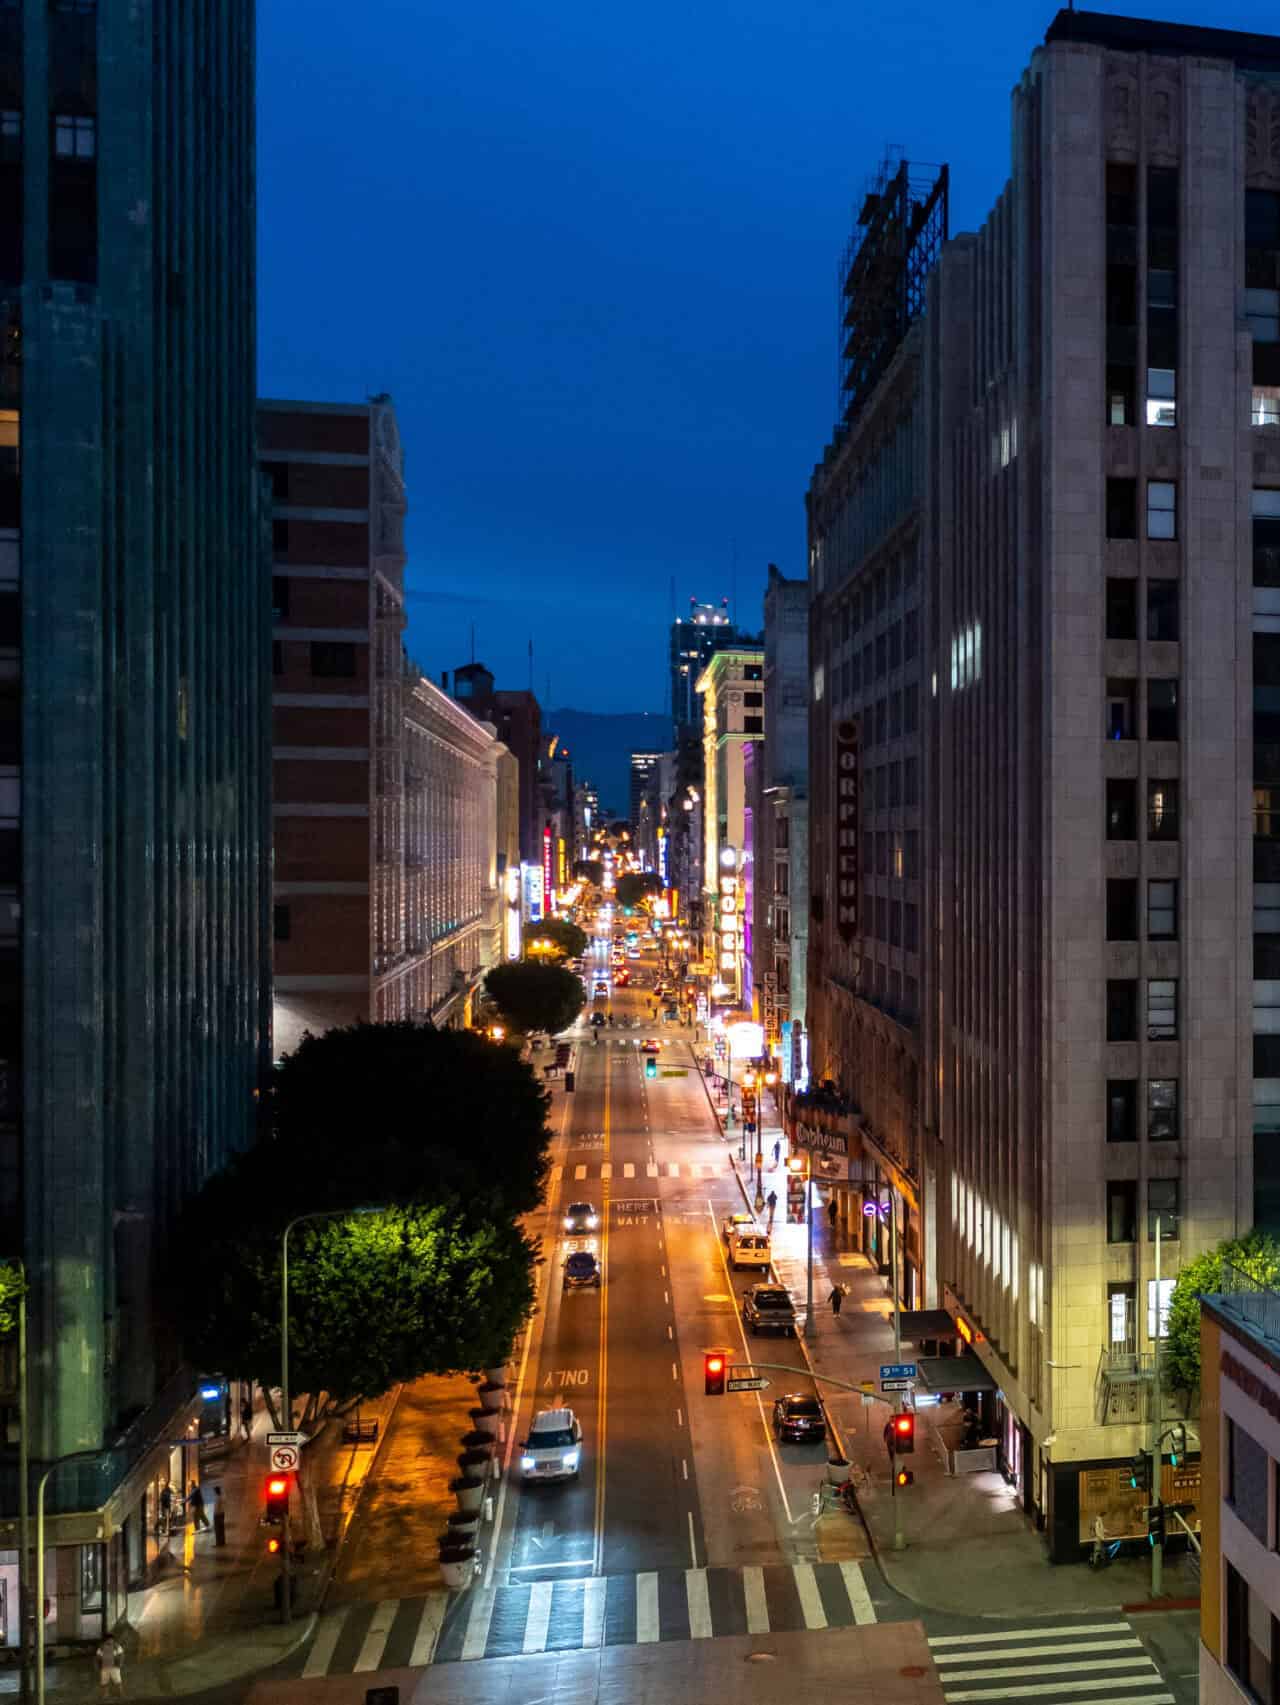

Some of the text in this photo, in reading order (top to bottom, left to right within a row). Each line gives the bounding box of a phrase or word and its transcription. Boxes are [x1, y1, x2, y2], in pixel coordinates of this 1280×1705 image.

[839, 750, 857, 924] ORPHEUM
[721, 877, 737, 968] TOER
[543, 1369, 589, 1386] ONLY
